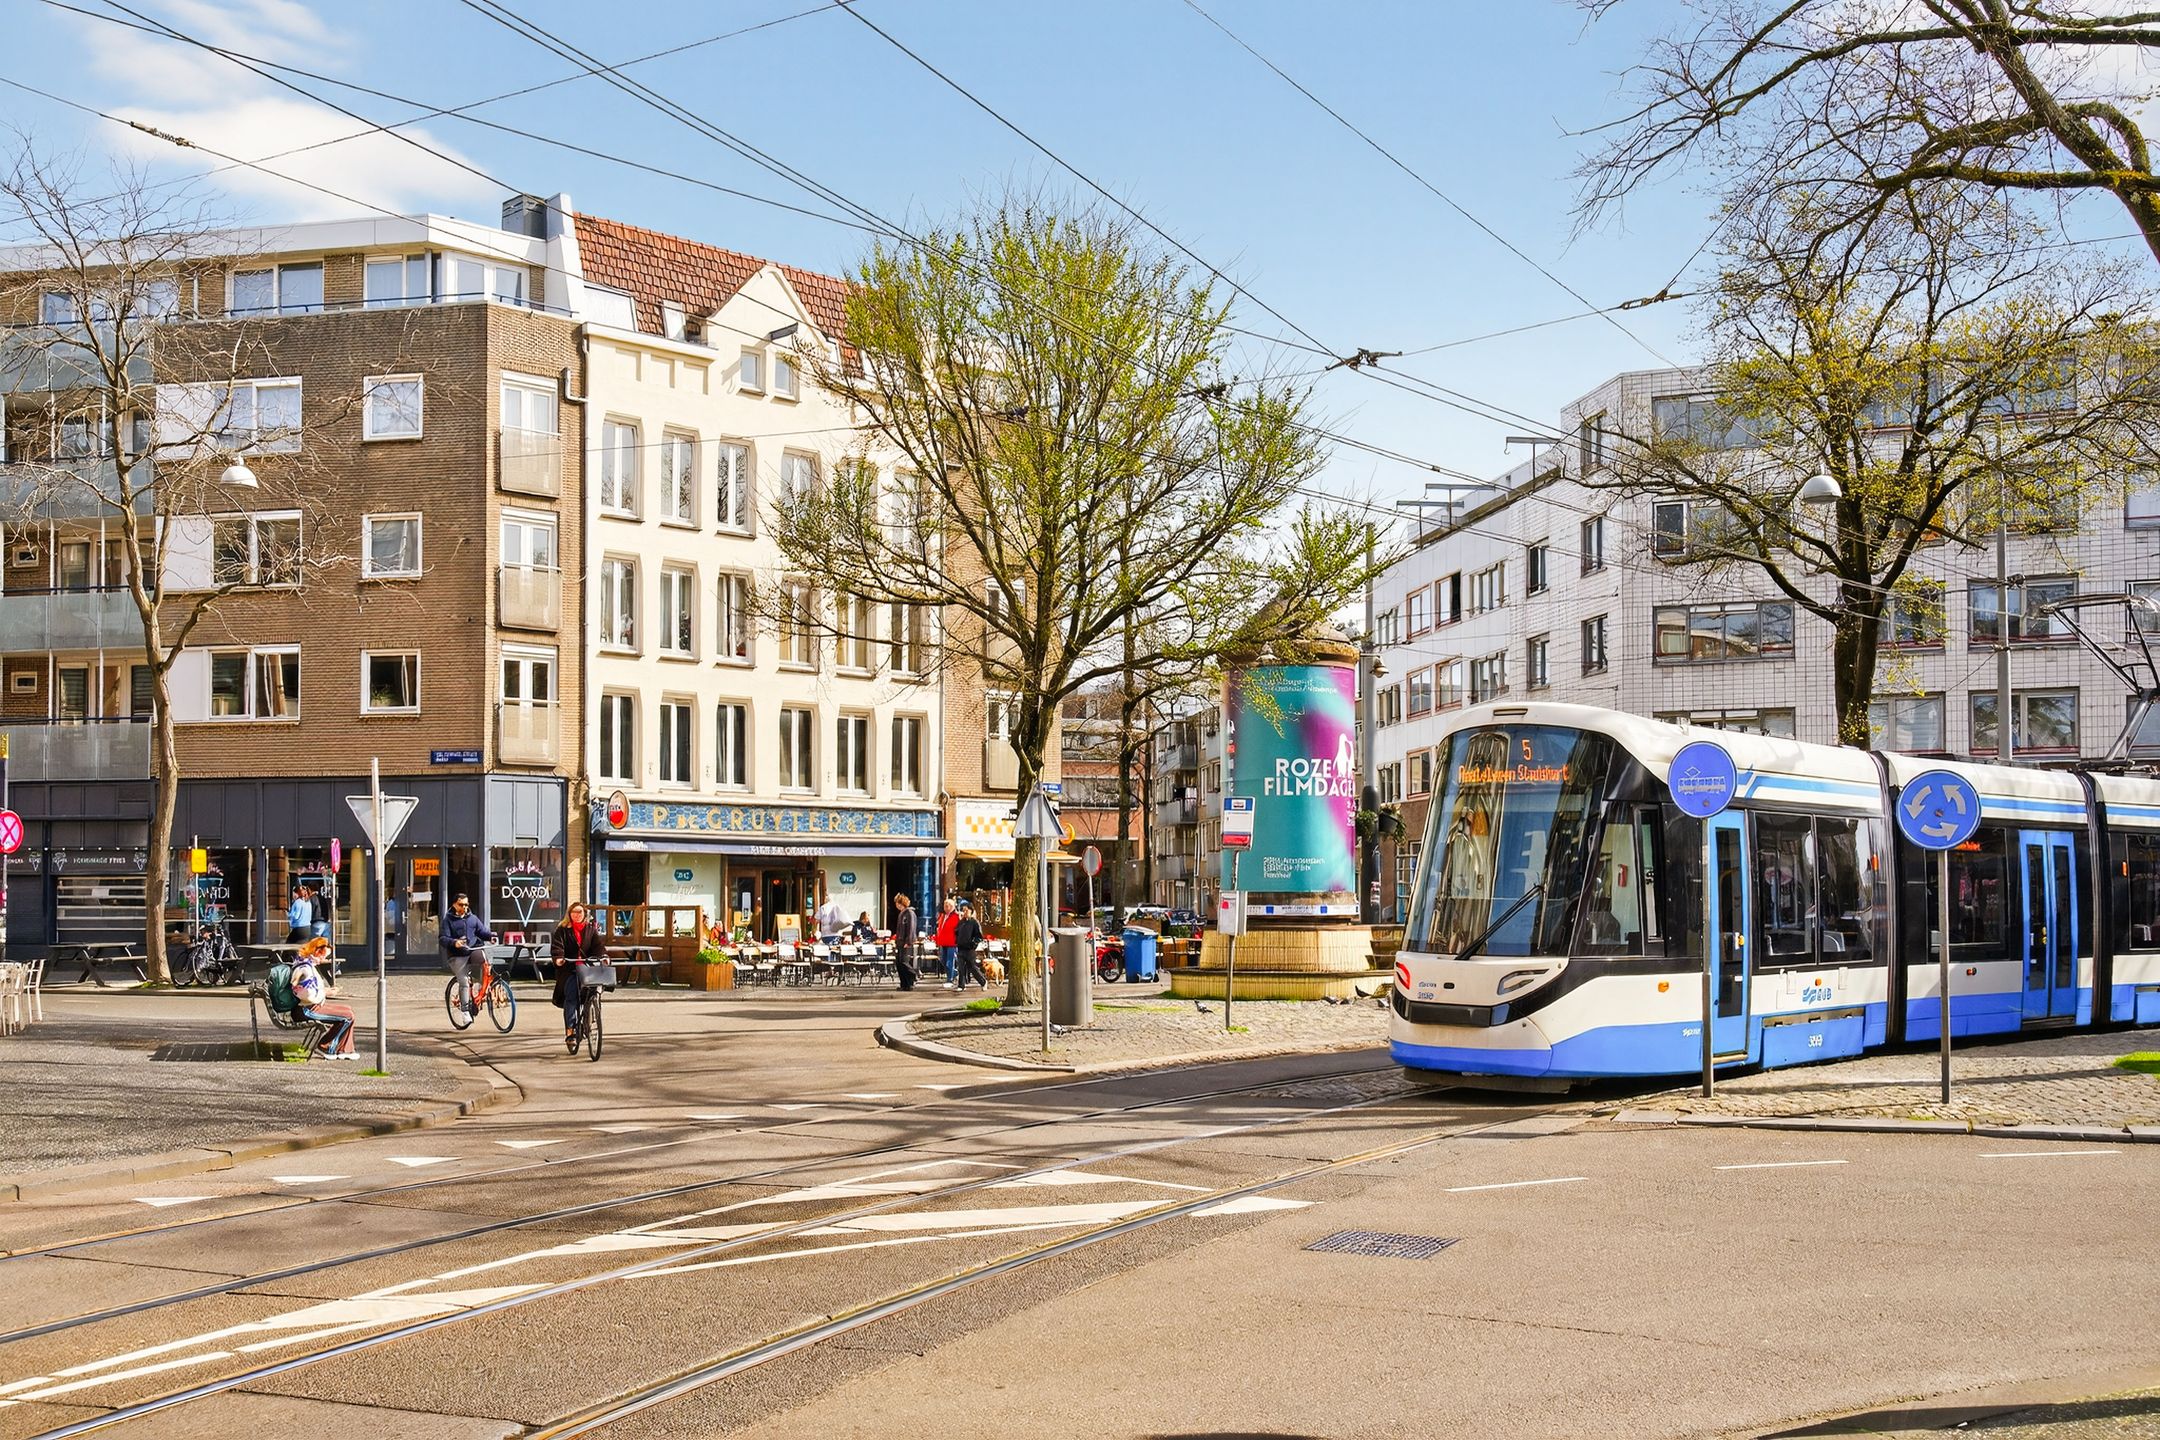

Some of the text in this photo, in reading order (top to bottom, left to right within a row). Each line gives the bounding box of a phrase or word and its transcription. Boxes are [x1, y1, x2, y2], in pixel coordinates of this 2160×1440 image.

[1521, 738, 1533, 761] 5
[1275, 758, 1332, 778] ROZE
[1264, 777, 1355, 797] FILMDAGE
[706, 806, 843, 833] GRUYTER
